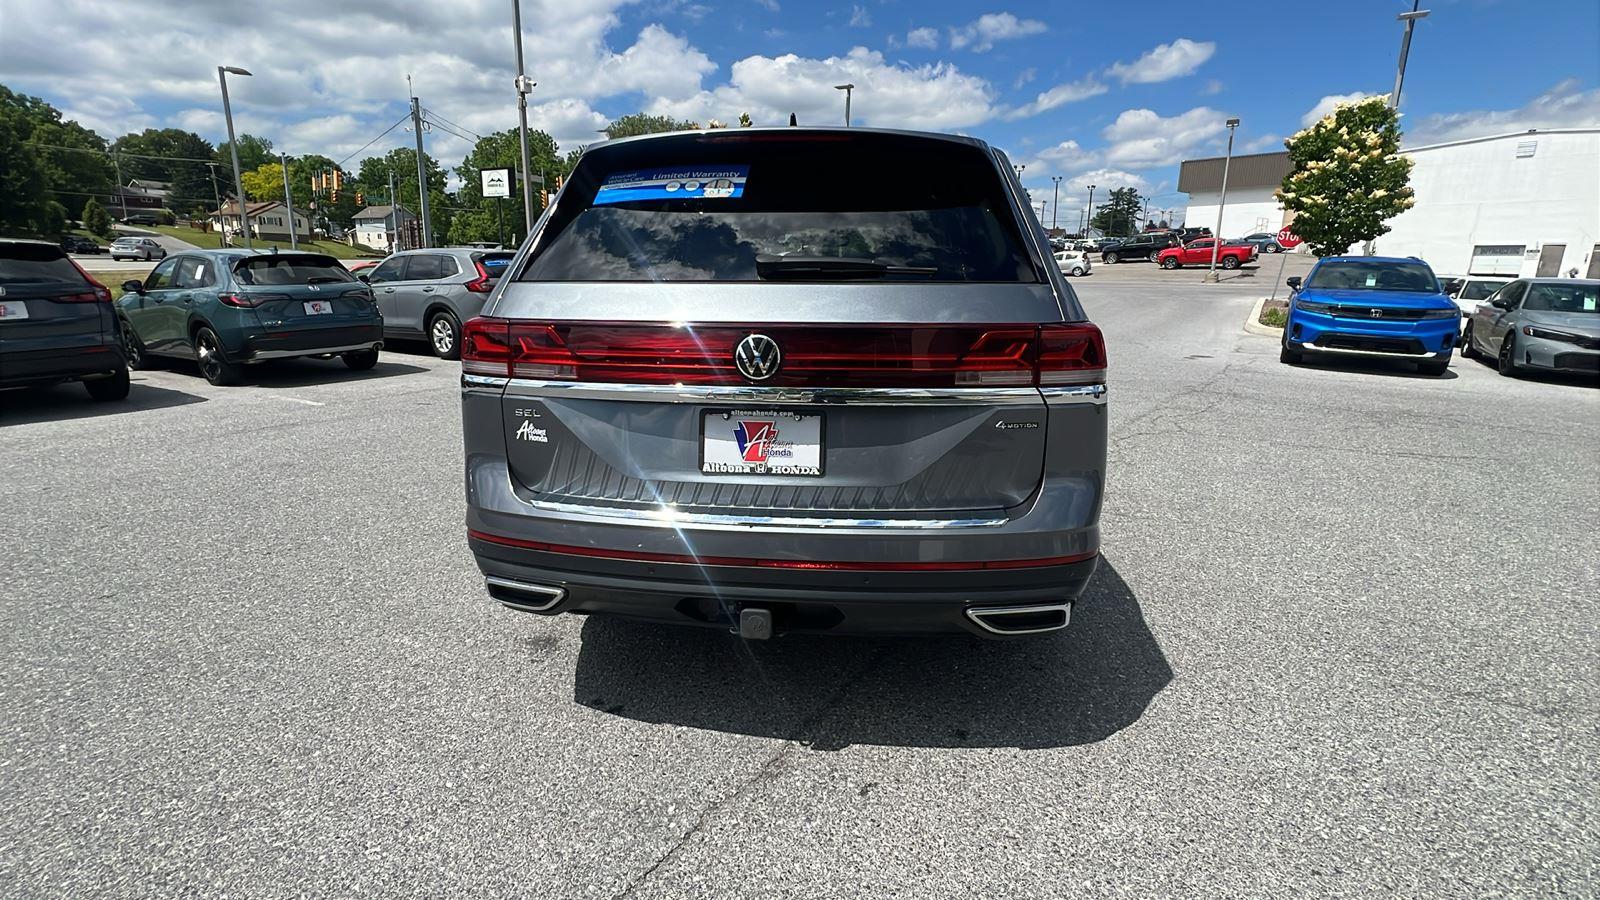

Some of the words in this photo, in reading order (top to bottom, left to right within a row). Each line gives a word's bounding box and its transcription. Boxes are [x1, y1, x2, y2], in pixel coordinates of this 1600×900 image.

[652, 172, 690, 180] Limited
[515, 408, 541, 417] SEL
[731, 409, 794, 417] altoonahonda.com
[763, 448, 792, 457] Honda
[702, 462, 752, 473] Altoona
[771, 465, 820, 475] HONDA
